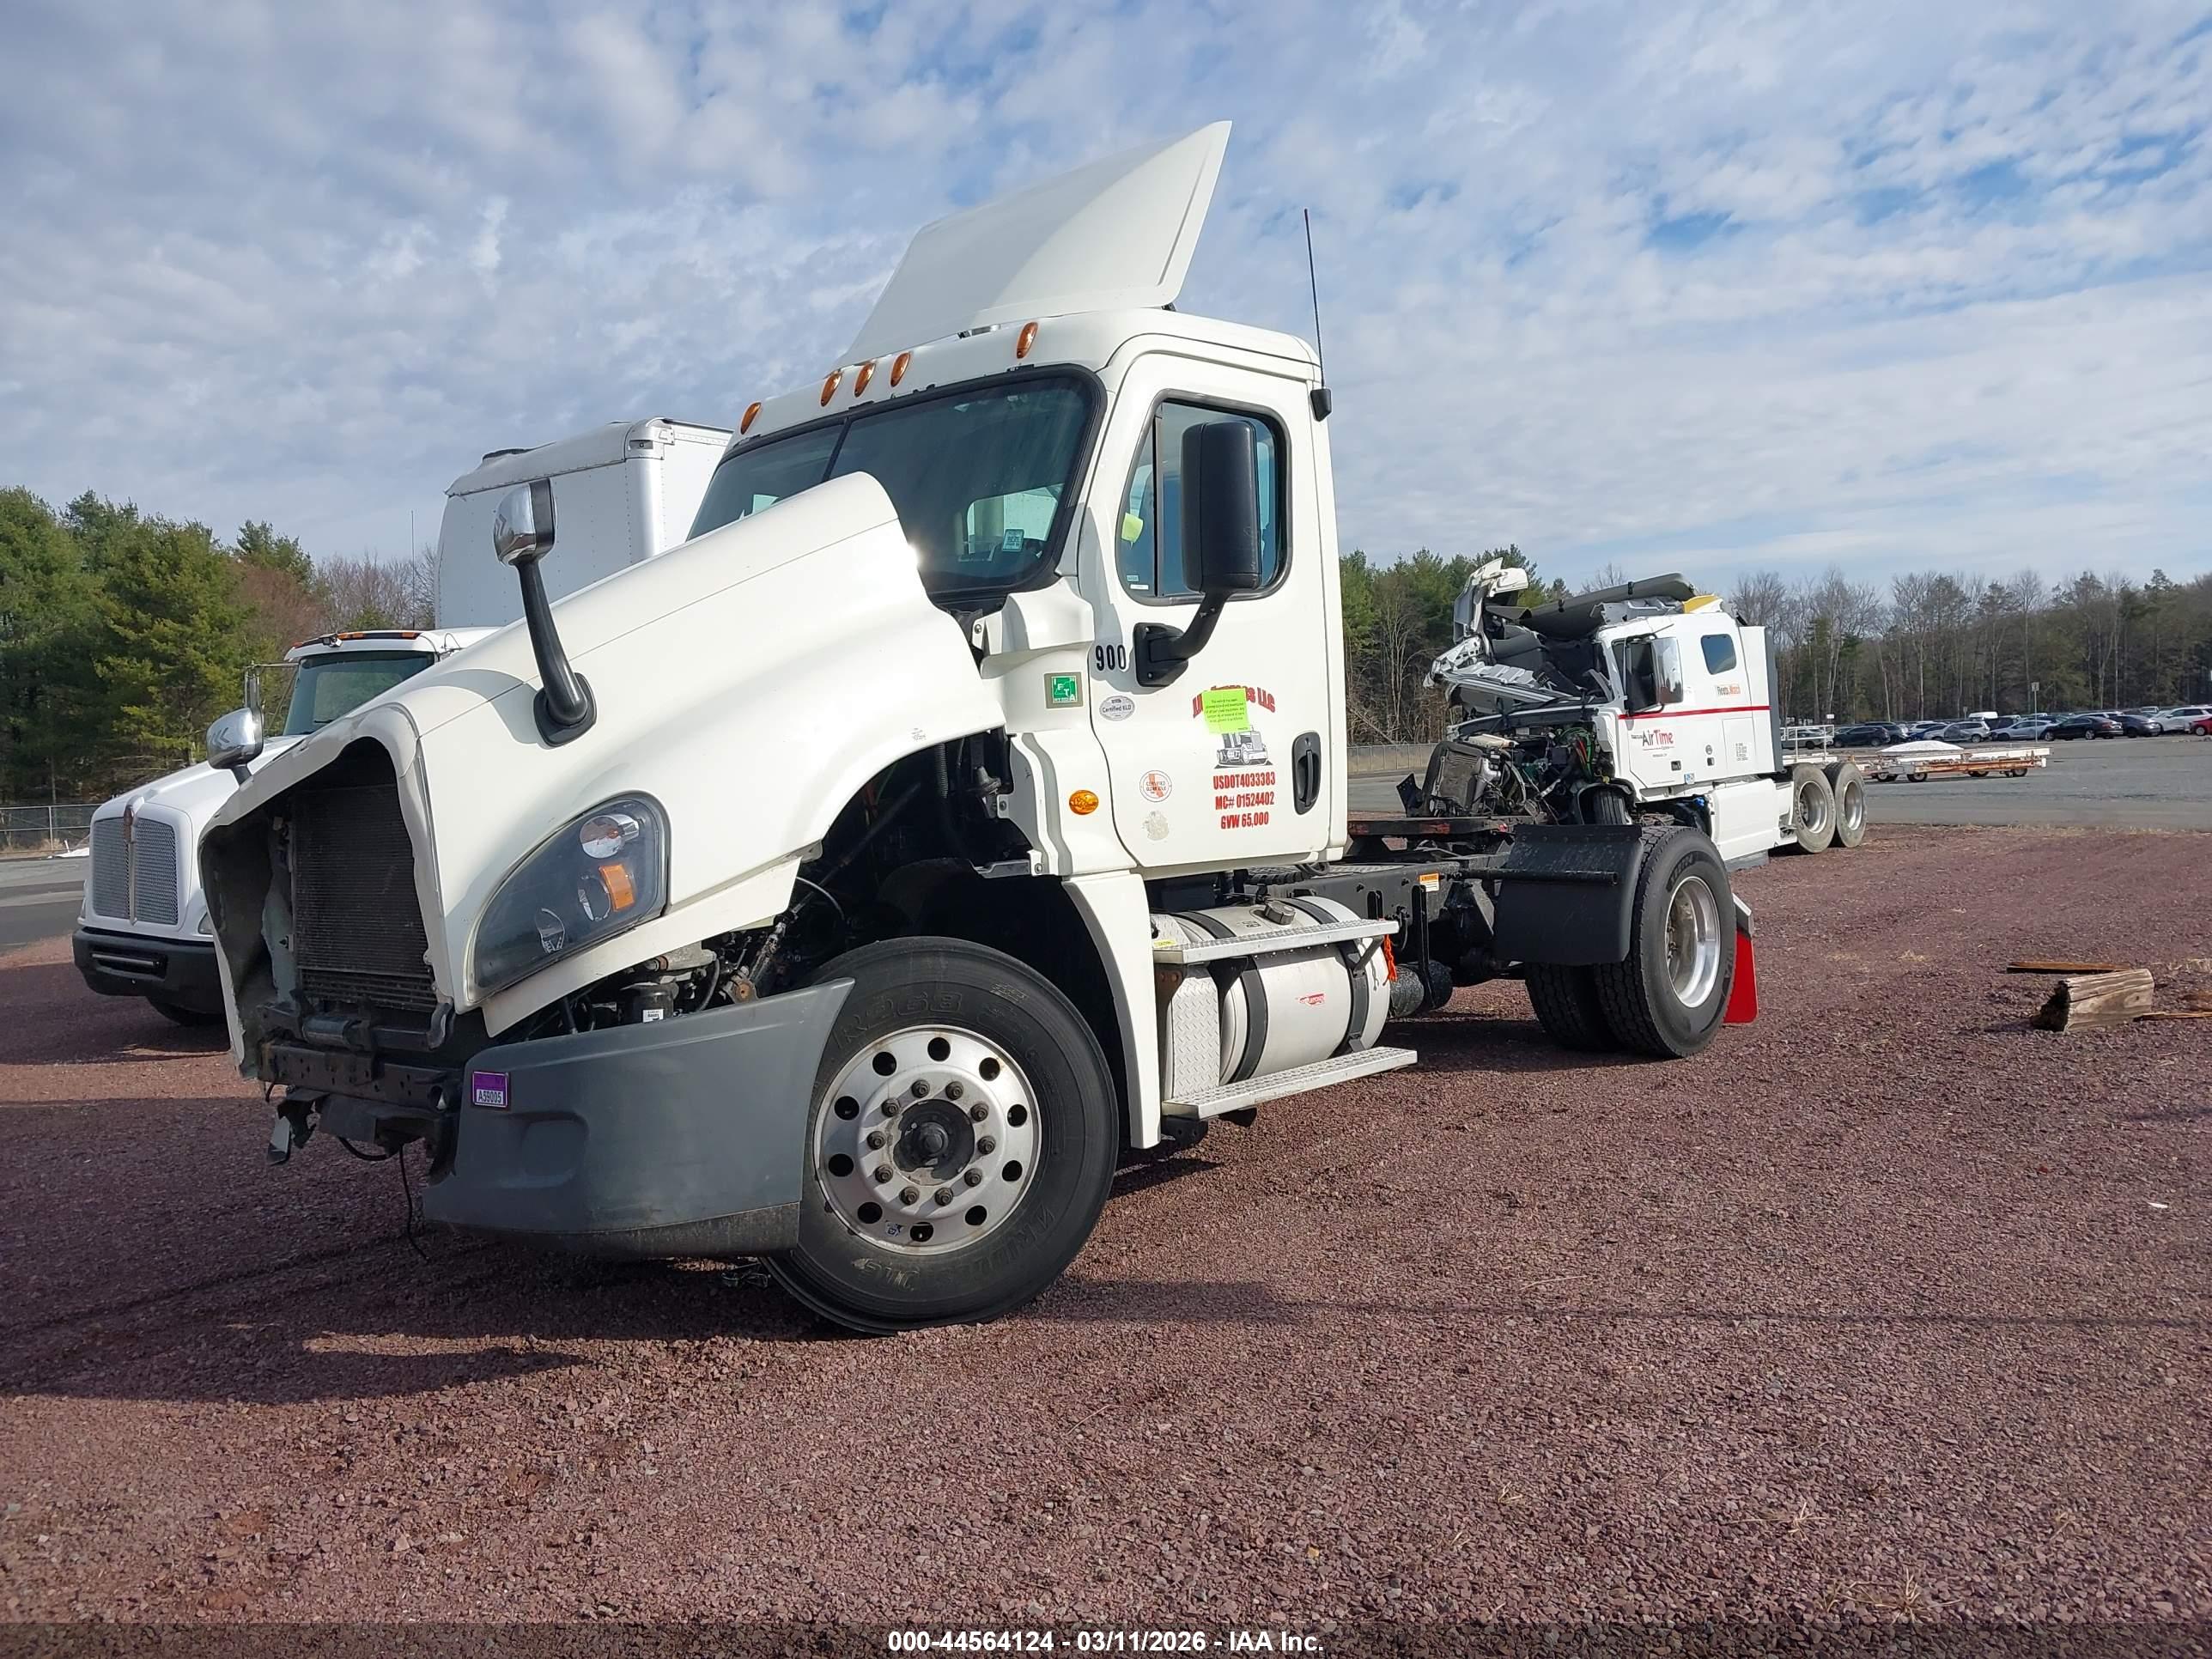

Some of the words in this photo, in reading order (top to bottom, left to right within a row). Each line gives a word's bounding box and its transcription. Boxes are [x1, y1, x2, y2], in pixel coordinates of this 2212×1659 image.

[1096, 645, 1126, 671] 900
[1256, 686, 1276, 713] LLC
[1102, 705, 1122, 714] Certified
[1213, 771, 1276, 790] USDOT4033383
[1215, 795, 1235, 810] MC#
[1237, 791, 1274, 808] 01524402
[1221, 814, 1240, 830] GVW
[1242, 811, 1269, 828] 65,000
